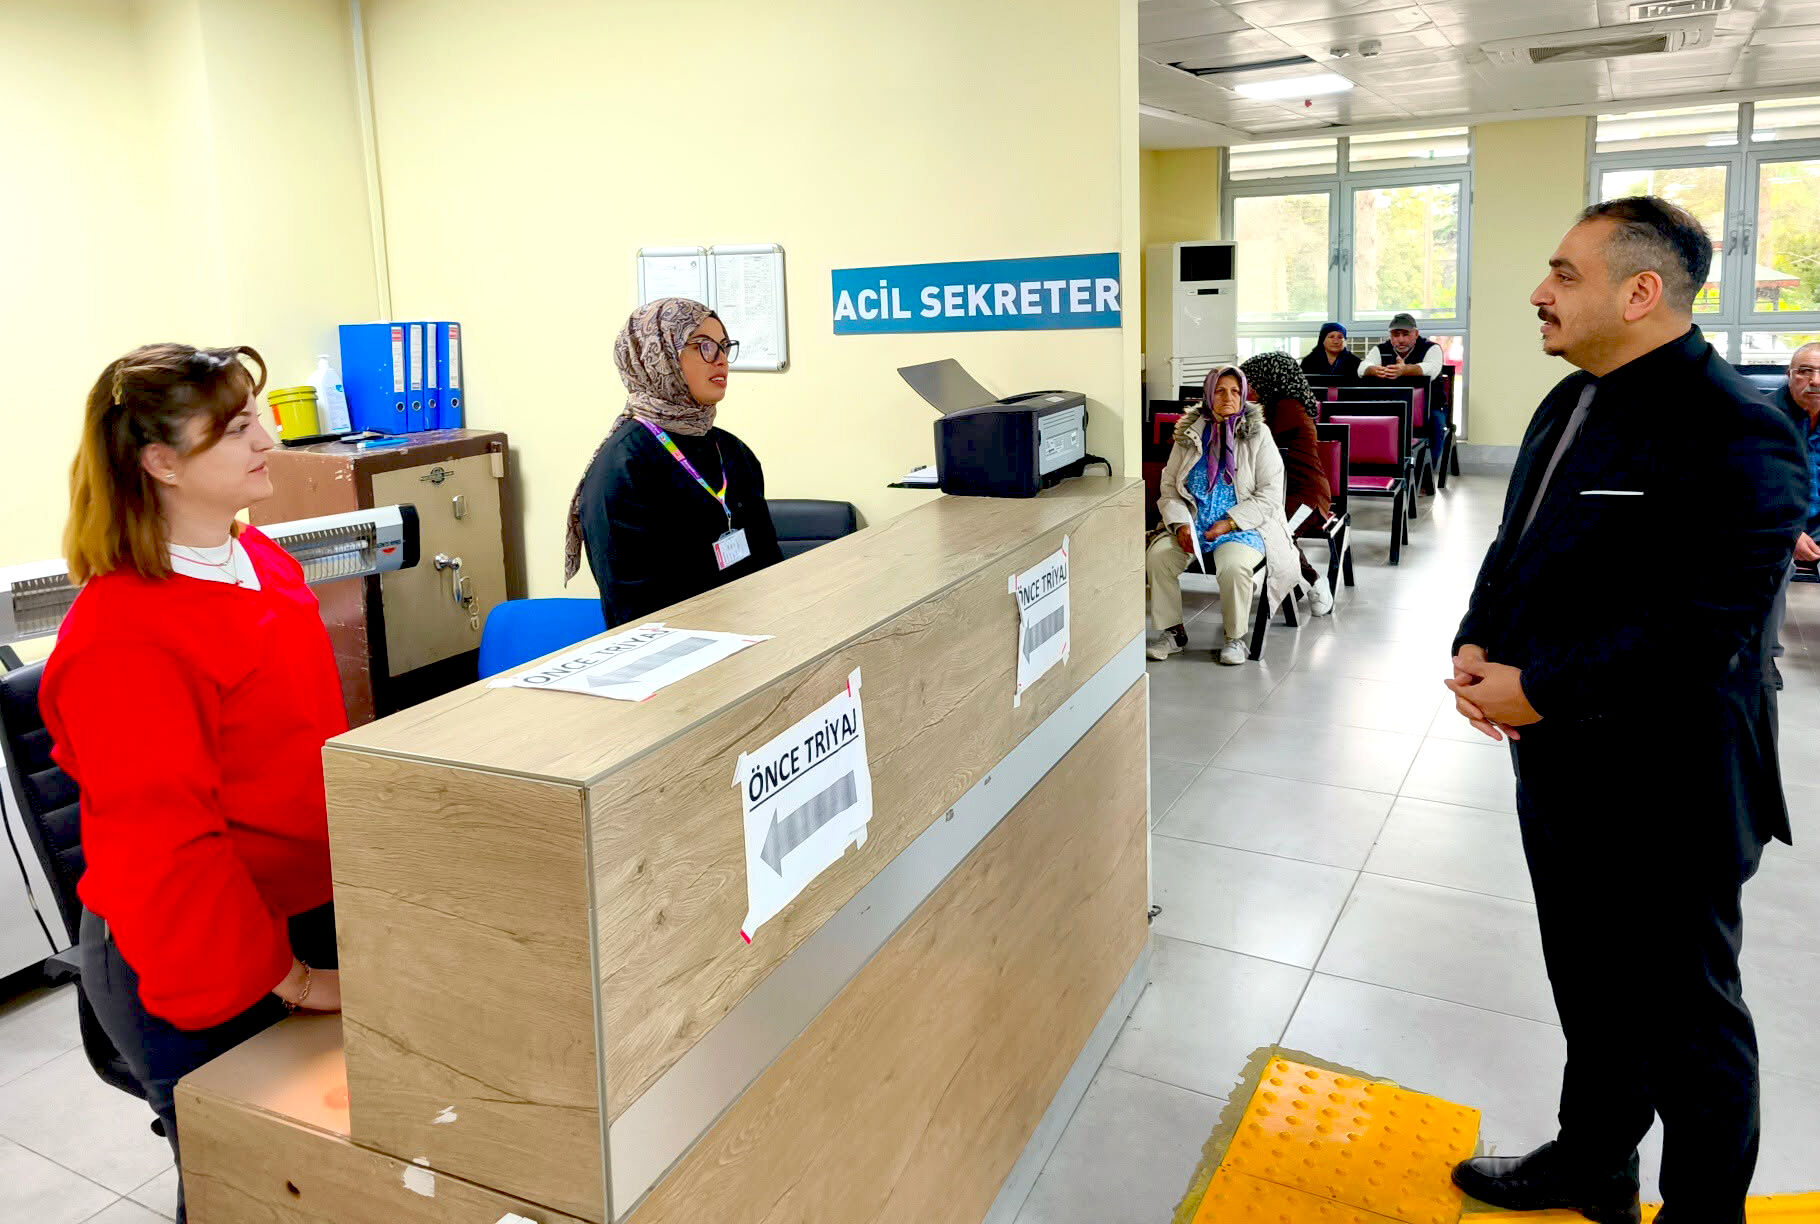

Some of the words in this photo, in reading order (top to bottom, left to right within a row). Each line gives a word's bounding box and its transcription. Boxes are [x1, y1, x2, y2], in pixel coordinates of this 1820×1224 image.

[834, 279, 912, 321] ACİL
[920, 277, 1121, 318] SEKRETER
[1042, 562, 1067, 592] TRİYAJ
[749, 746, 800, 802] ÖNCE
[804, 708, 857, 764] TRİYAJ
